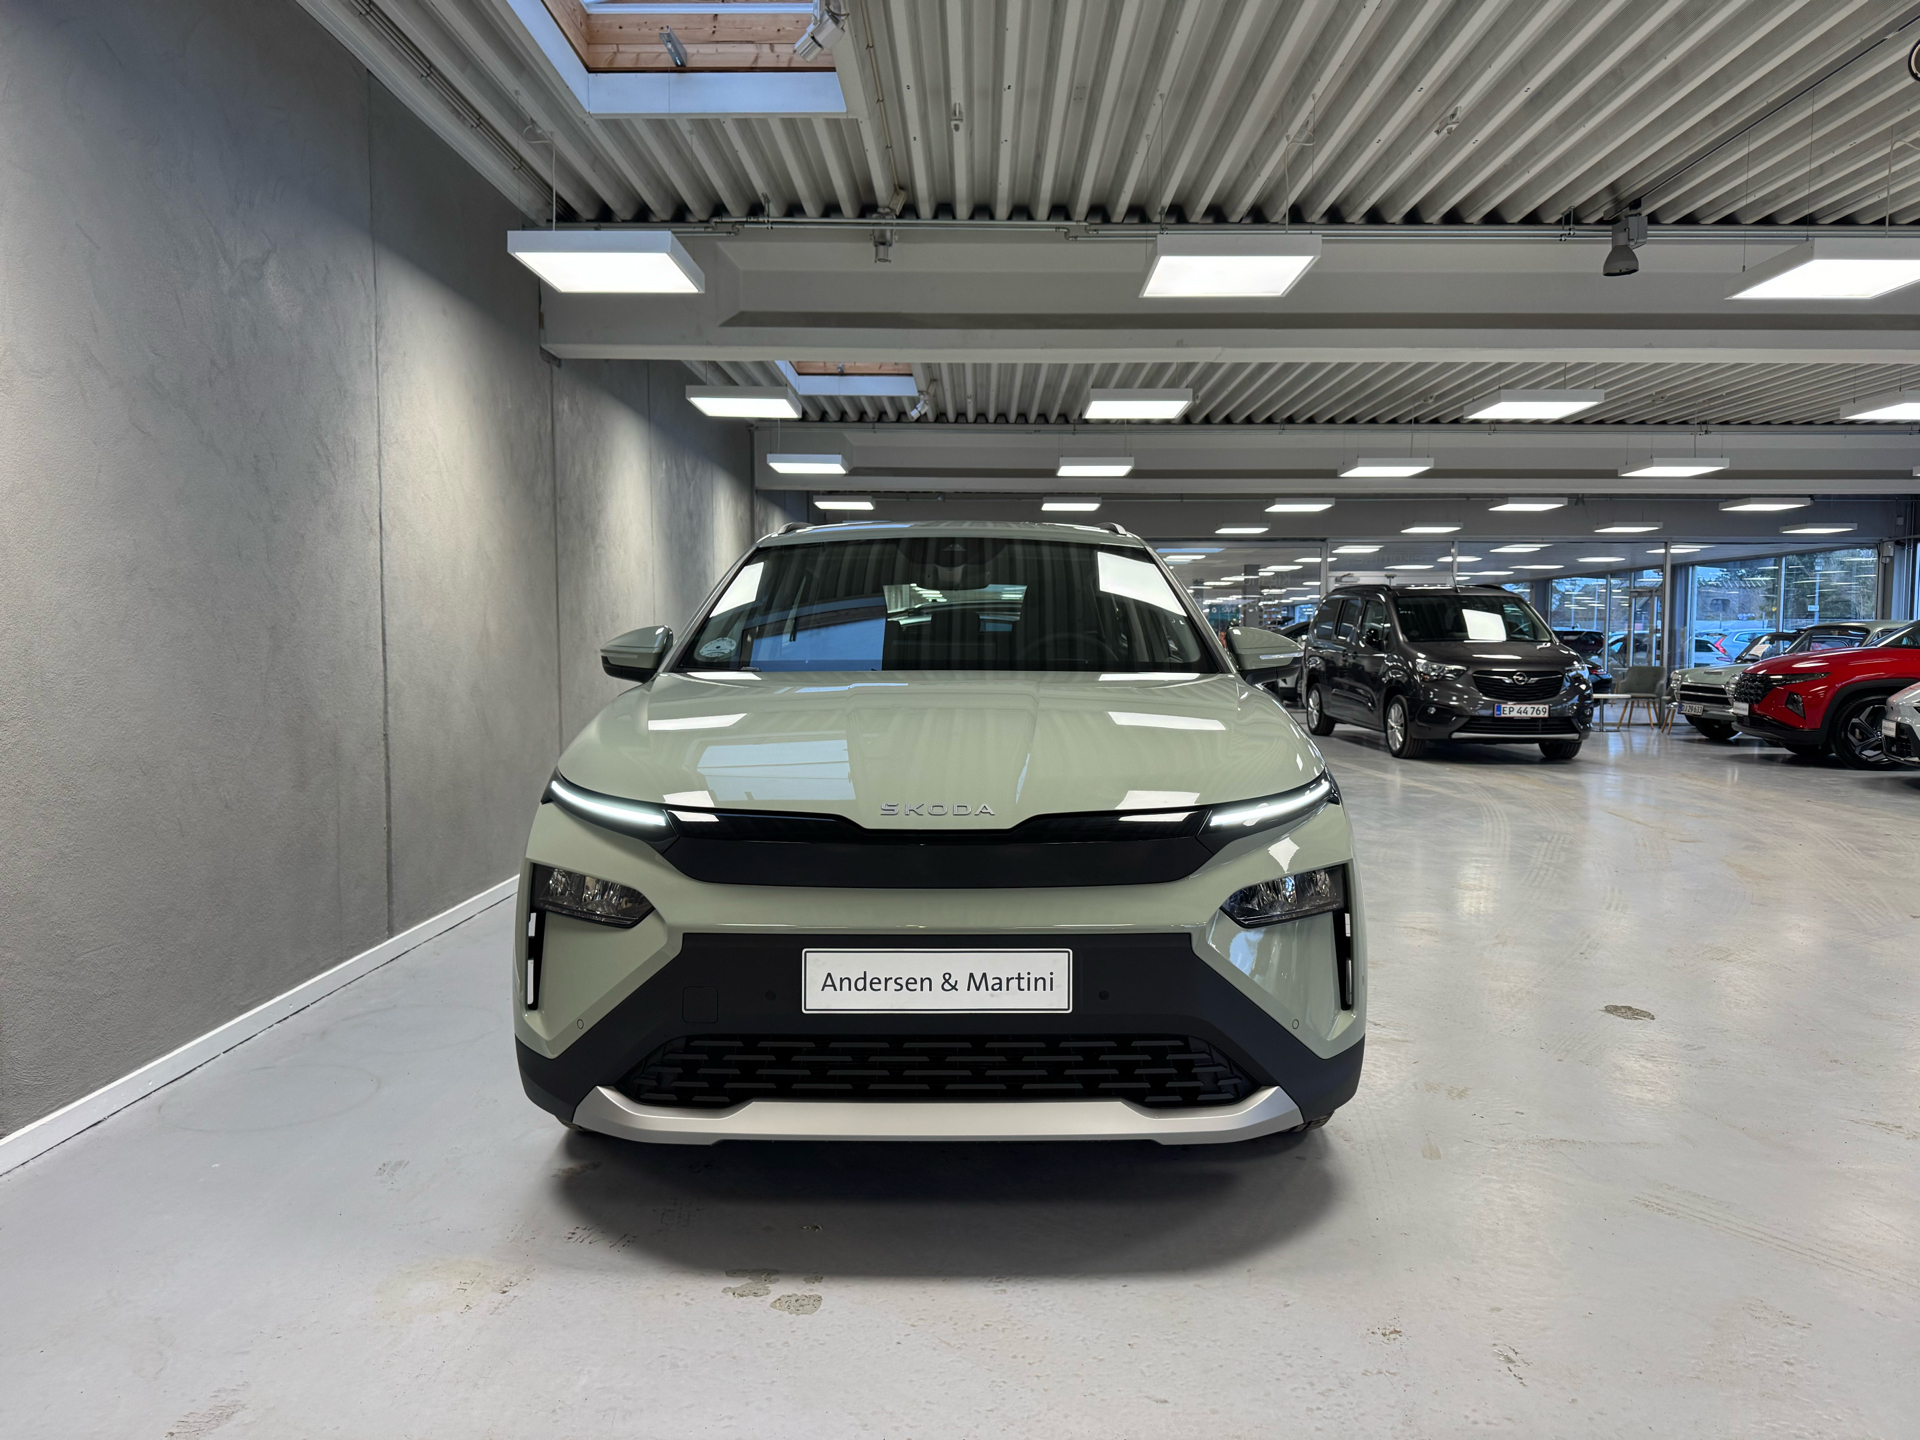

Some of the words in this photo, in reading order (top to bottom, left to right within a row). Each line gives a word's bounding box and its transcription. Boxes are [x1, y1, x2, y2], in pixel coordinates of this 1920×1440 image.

[1502, 706, 1515, 715] EP
[821, 971, 933, 992] Andersen
[940, 972, 959, 992] &
[967, 971, 1055, 992] Martini
